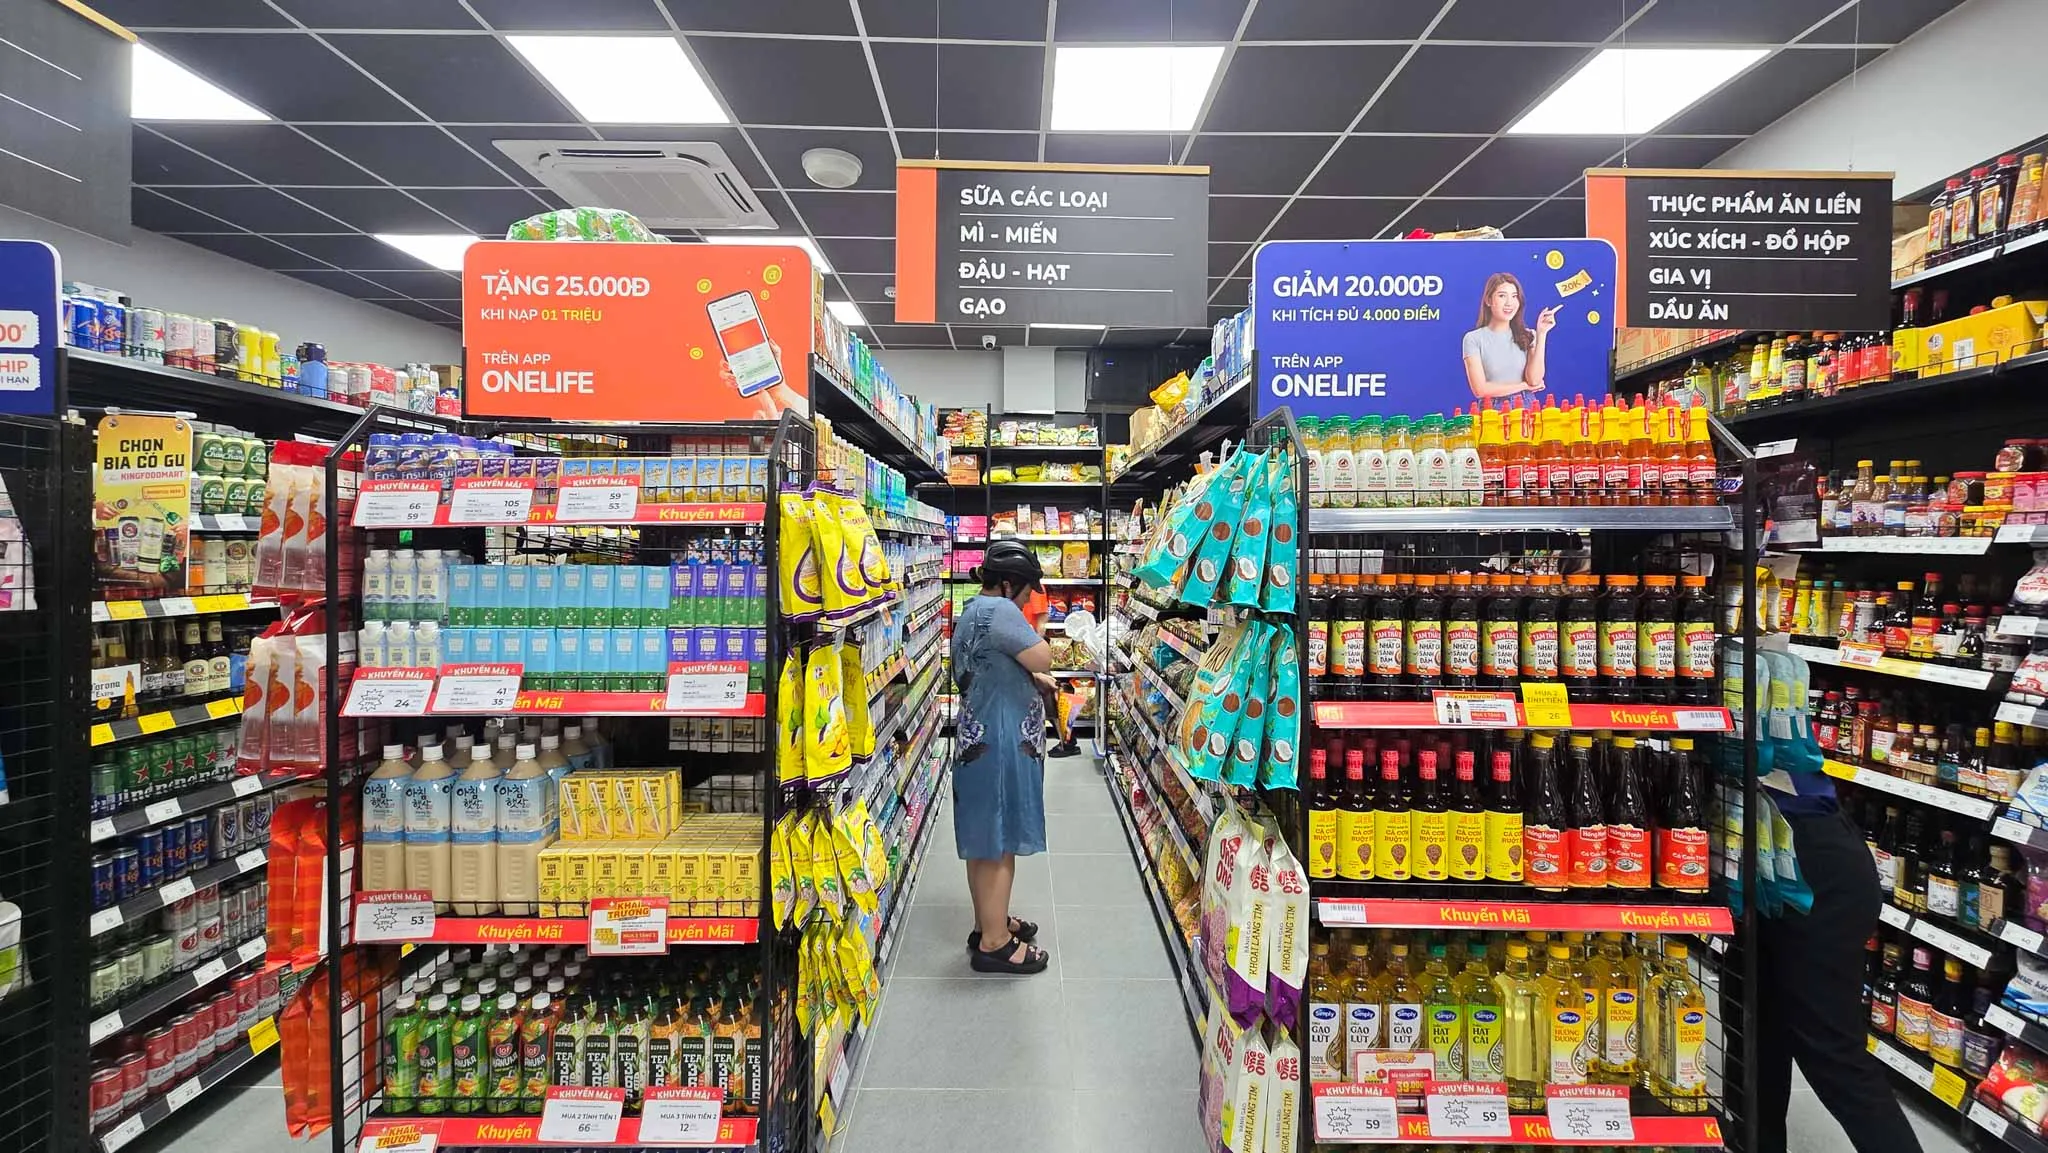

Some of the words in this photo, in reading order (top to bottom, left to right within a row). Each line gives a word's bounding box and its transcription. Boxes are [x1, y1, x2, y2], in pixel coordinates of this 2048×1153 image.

[960, 184, 1004, 206] SỮA
[1010, 185, 1053, 207] CÁC
[1059, 190, 1108, 212] LOẠI
[1648, 193, 1706, 217] THỰC
[1711, 190, 1773, 214] PHẨM
[1778, 192, 1810, 214] ĂN
[1815, 191, 1861, 215] LIỀN
[960, 220, 984, 243] MÌ
[1005, 221, 1057, 244] MIẾN
[1648, 227, 1692, 249] XÚC
[1697, 228, 1746, 250] XÍCH
[1765, 227, 1798, 250] ĐỒ
[1803, 229, 1850, 255] HỘP
[958, 257, 1006, 284] ĐẬU
[1027, 263, 1070, 285] HẠT
[481, 269, 549, 301] TẶNG
[555, 276, 650, 297] 25.000Đ
[1272, 269, 1338, 298] GIẢM
[1344, 276, 1443, 297] 20.000Đ
[1561, 279, 1582, 292] 20K
[1648, 268, 1685, 285] GIA
[1690, 268, 1712, 290] VỊ
[481, 309, 505, 321] KHI
[509, 309, 538, 323] NẠP
[541, 309, 558, 321] 01
[561, 306, 602, 324] TRIỆU
[959, 297, 1006, 319] GẠO
[1272, 309, 1296, 321] KHI
[1300, 307, 1334, 322] TÍCH
[1337, 305, 1358, 322] ĐỦ
[1362, 309, 1400, 321] 4.000
[1403, 304, 1440, 321] ĐIỂM
[1649, 297, 1694, 320] DẦU
[1698, 299, 1729, 320] ĂN
[482, 350, 519, 364] TRÊN
[522, 353, 551, 365] APP
[1272, 353, 1310, 368] TRÊN
[1313, 356, 1343, 369] APP
[481, 370, 594, 394] ONELIFE
[1271, 373, 1387, 397] ONELIFE
[120, 438, 164, 455] CHỌN
[103, 456, 131, 470] BIA
[137, 452, 158, 468] CÓ
[164, 453, 185, 467] GU
[120, 470, 185, 480] KINGFOODMART
[409, 502, 421, 510] 66
[659, 507, 714, 522] Khuyến
[718, 507, 745, 519] Mãi
[723, 691, 736, 699] 35
[394, 699, 410, 708] 24
[535, 697, 564, 711] Mãi
[1610, 709, 1669, 726] Khuyến
[364, 784, 387, 798] 아침
[405, 786, 426, 800] 아침
[1215, 859, 1231, 891] One
[617, 900, 641, 909] KHAI
[411, 916, 424, 925] 53
[1440, 907, 1498, 924] Khuyến
[1502, 908, 1530, 923] Mãi
[1620, 911, 1680, 929] Khuyến
[1682, 912, 1712, 926] Mãi
[477, 923, 533, 940] Khuyến
[536, 924, 563, 939] Mãi
[670, 923, 704, 940] uyến
[708, 924, 735, 939] Mãi
[1251, 921, 1261, 944] LANG
[1284, 922, 1294, 945] LANG
[1316, 1010, 1334, 1019] Simply
[1354, 1010, 1374, 1019] Simply
[1397, 1010, 1416, 1019] Simply
[1436, 1013, 1455, 1021] Simply
[1475, 1013, 1495, 1021] Simply
[1559, 1013, 1579, 1022] Simply
[1216, 1025, 1232, 1066] One
[555, 1052, 573, 1061] TEA
[587, 1053, 607, 1061] TEA
[619, 1052, 637, 1061] TEA
[651, 1055, 669, 1064] TEA
[1256, 1051, 1266, 1076] One
[1289, 1057, 1299, 1081] One
[1482, 1111, 1497, 1121] 59
[390, 1124, 416, 1135] KHAI
[476, 1122, 532, 1140] Khuyến
[578, 1123, 591, 1132] 66
[679, 1123, 690, 1132] 12
[1365, 1119, 1381, 1129] 59
[1407, 1121, 1430, 1136] Mã
[1605, 1120, 1620, 1130] 59
[720, 1125, 733, 1139] ãi
